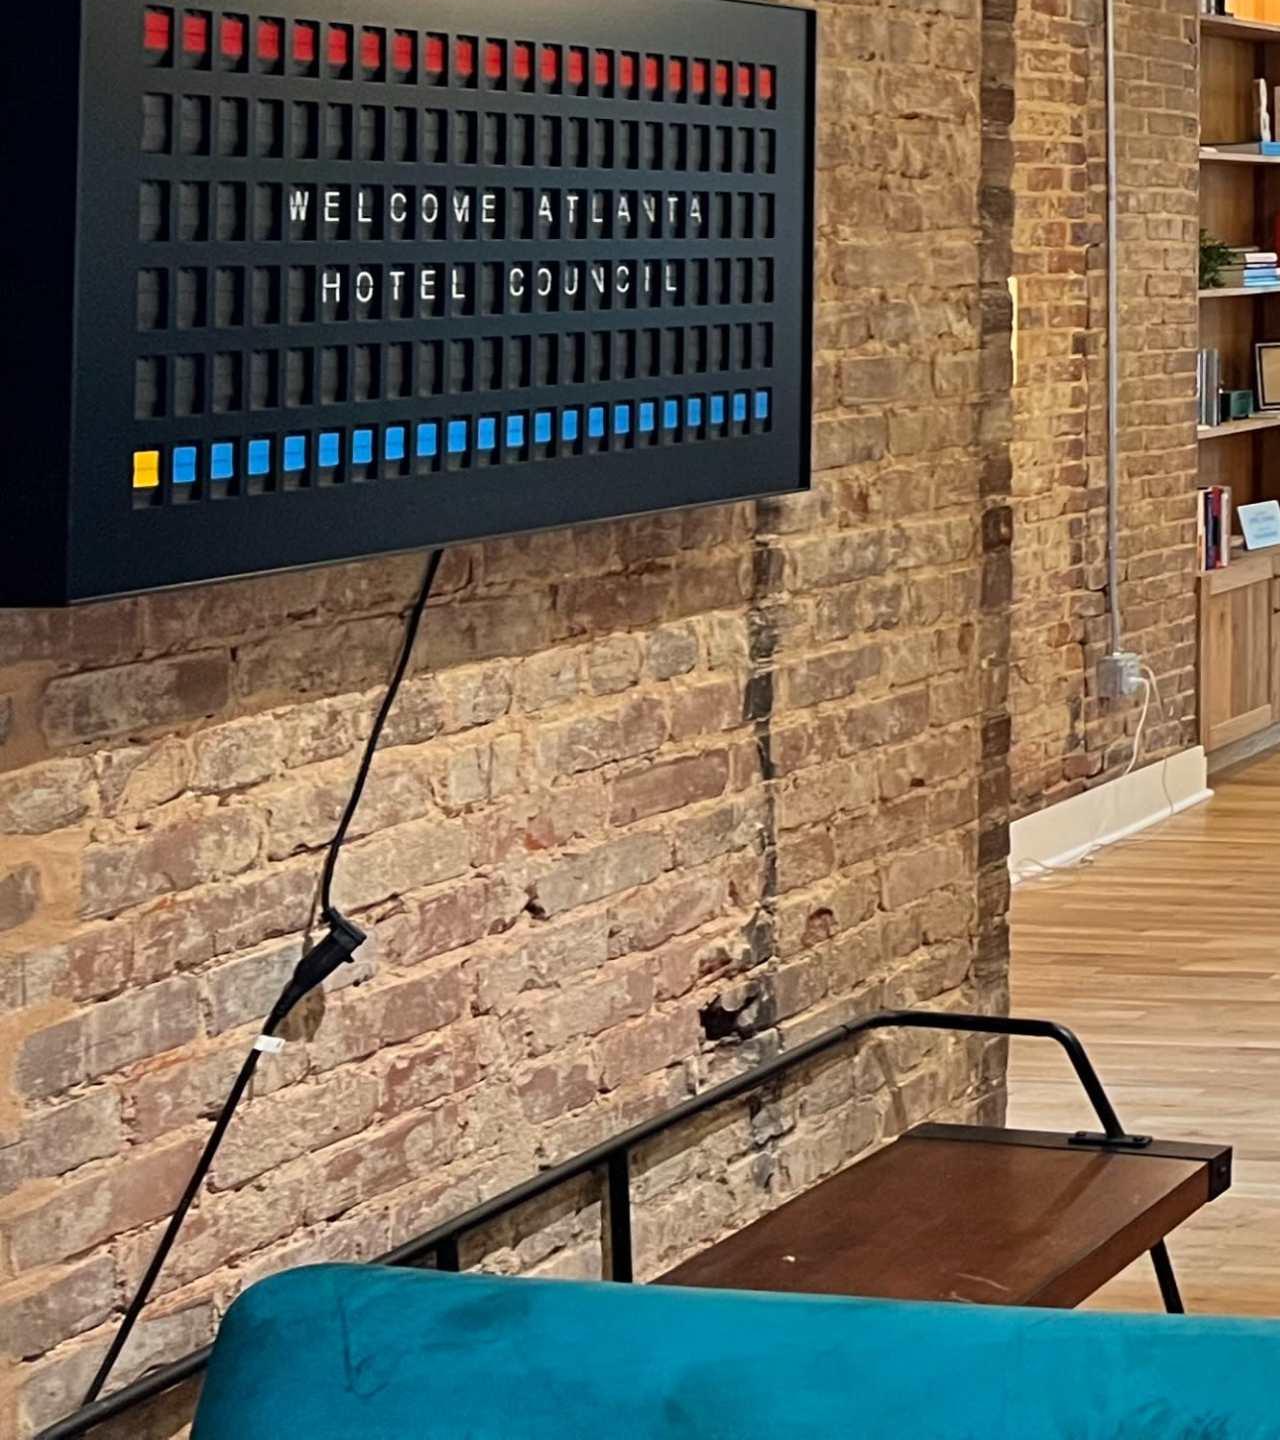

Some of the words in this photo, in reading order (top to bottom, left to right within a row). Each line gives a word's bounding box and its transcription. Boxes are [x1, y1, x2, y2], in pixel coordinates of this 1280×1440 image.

[289, 191, 496, 223] WELCOME
[538, 194, 702, 224] ATLANTA
[322, 268, 466, 304] HOTEL
[509, 265, 678, 297] COUNCIL
